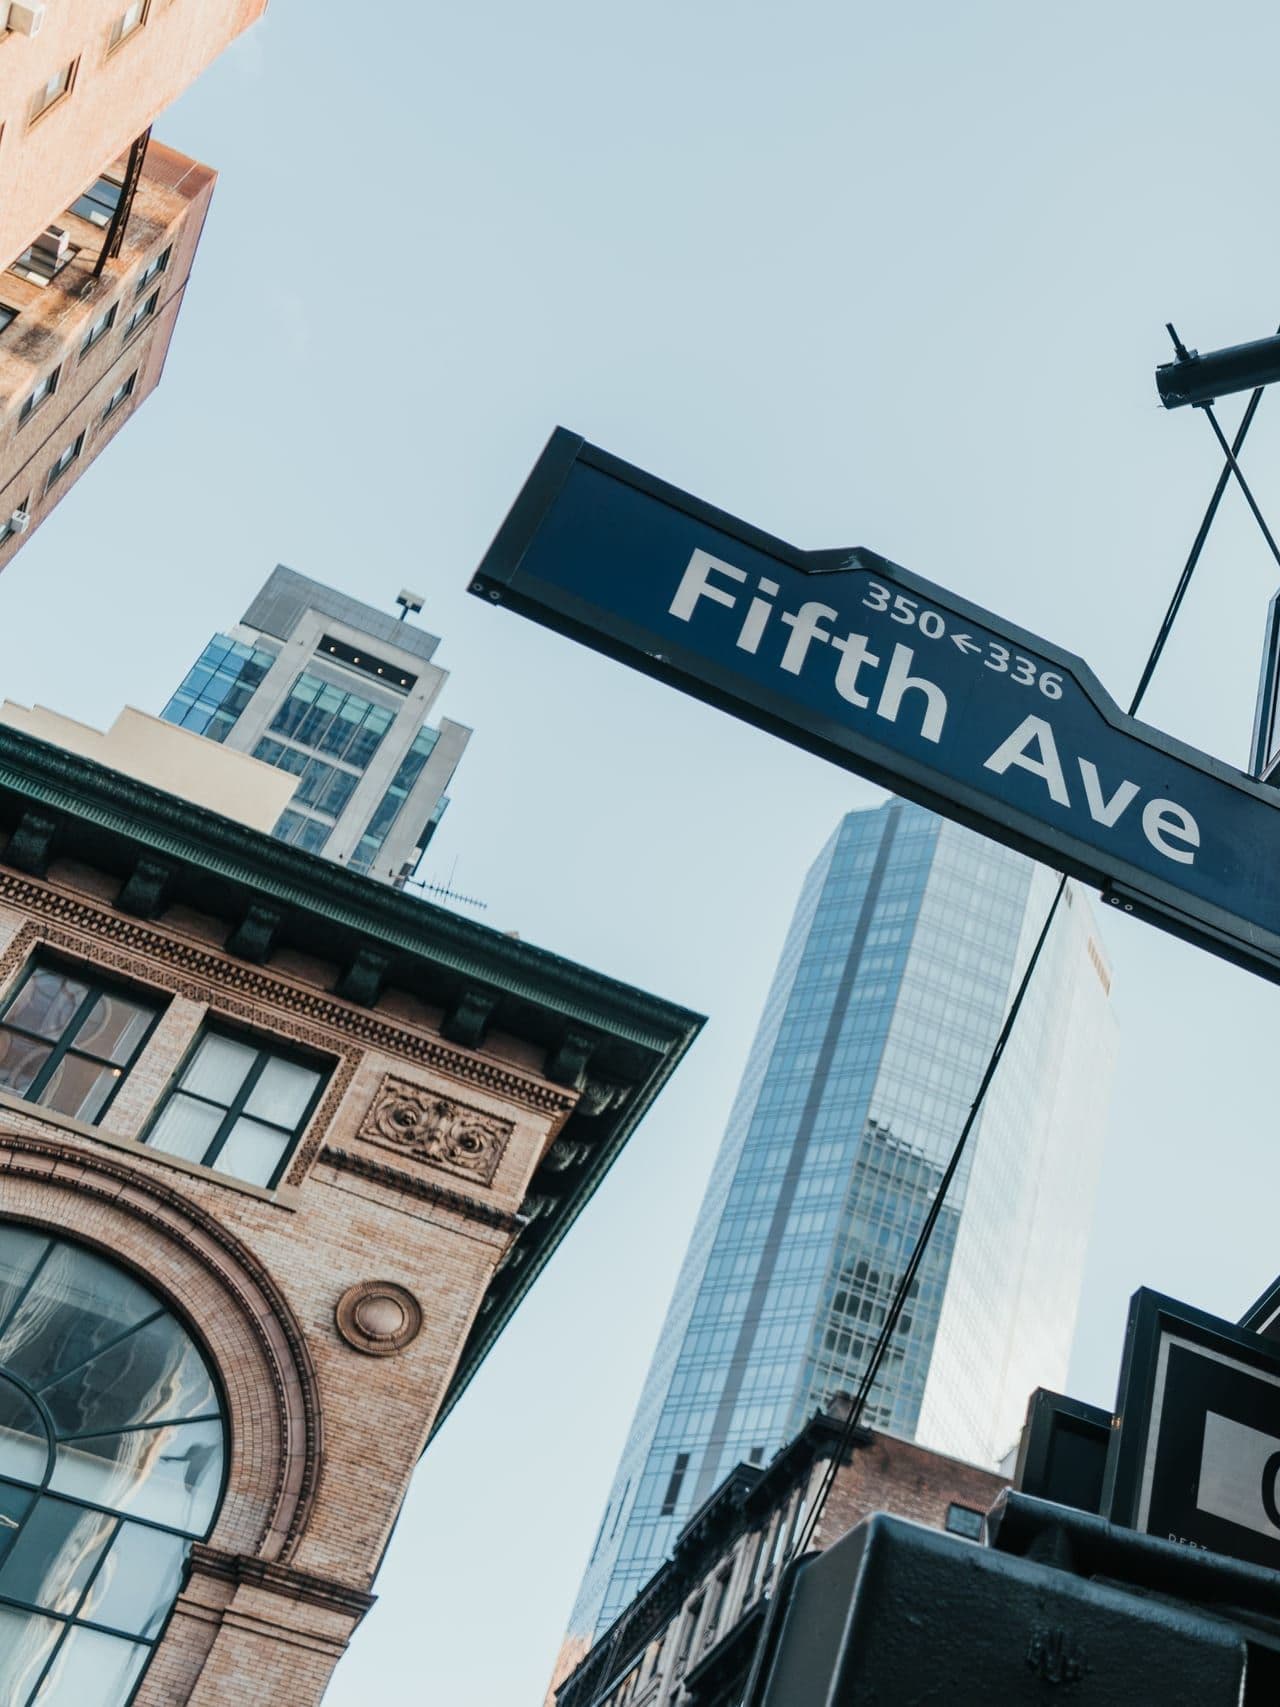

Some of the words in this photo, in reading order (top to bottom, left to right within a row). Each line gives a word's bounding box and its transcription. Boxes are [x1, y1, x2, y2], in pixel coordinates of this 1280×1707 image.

[668, 547, 948, 744] Fifth
[983, 714, 1202, 866] Ave
[862, 581, 946, 640] 350
[983, 641, 1064, 700] 336
